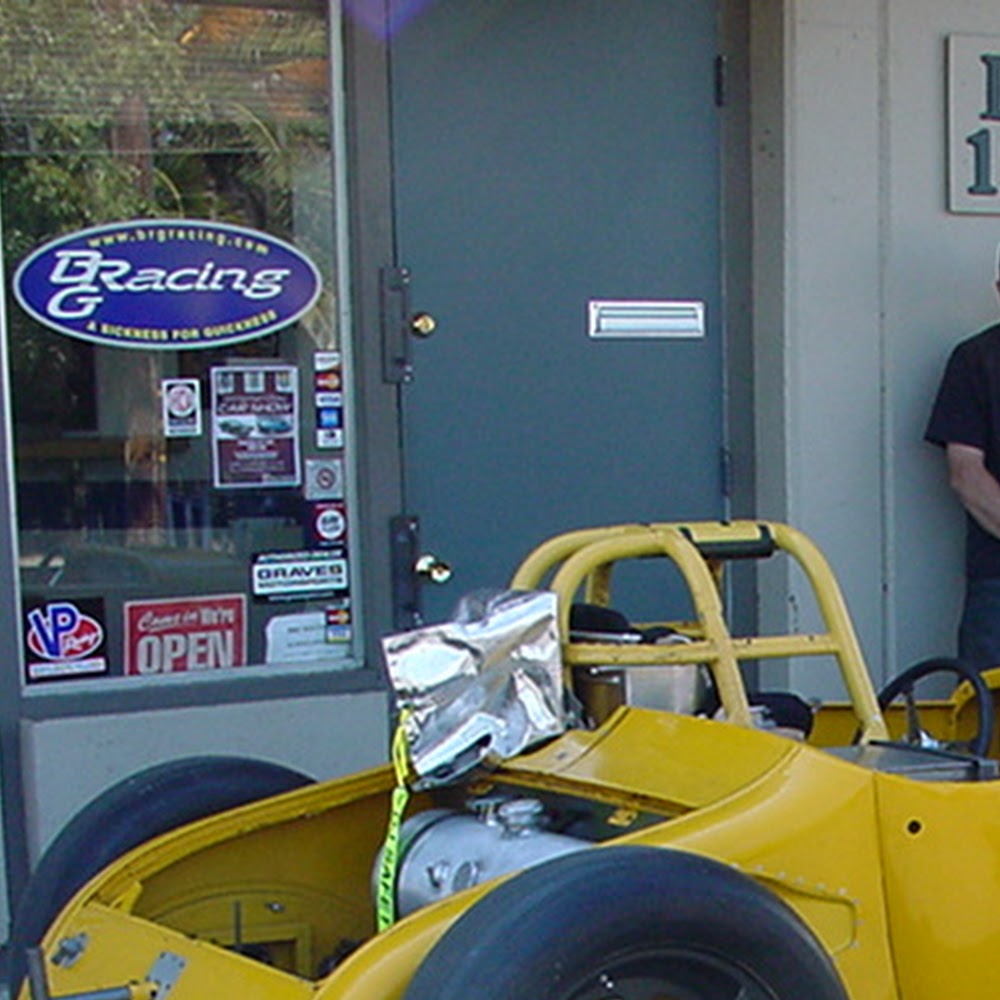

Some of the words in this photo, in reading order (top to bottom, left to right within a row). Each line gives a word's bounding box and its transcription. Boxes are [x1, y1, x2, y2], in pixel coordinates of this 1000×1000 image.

[172, 329, 200, 341] FOR
[257, 564, 343, 579] GRAVES
[30, 605, 78, 658] VP
[137, 629, 235, 675] OPEN
